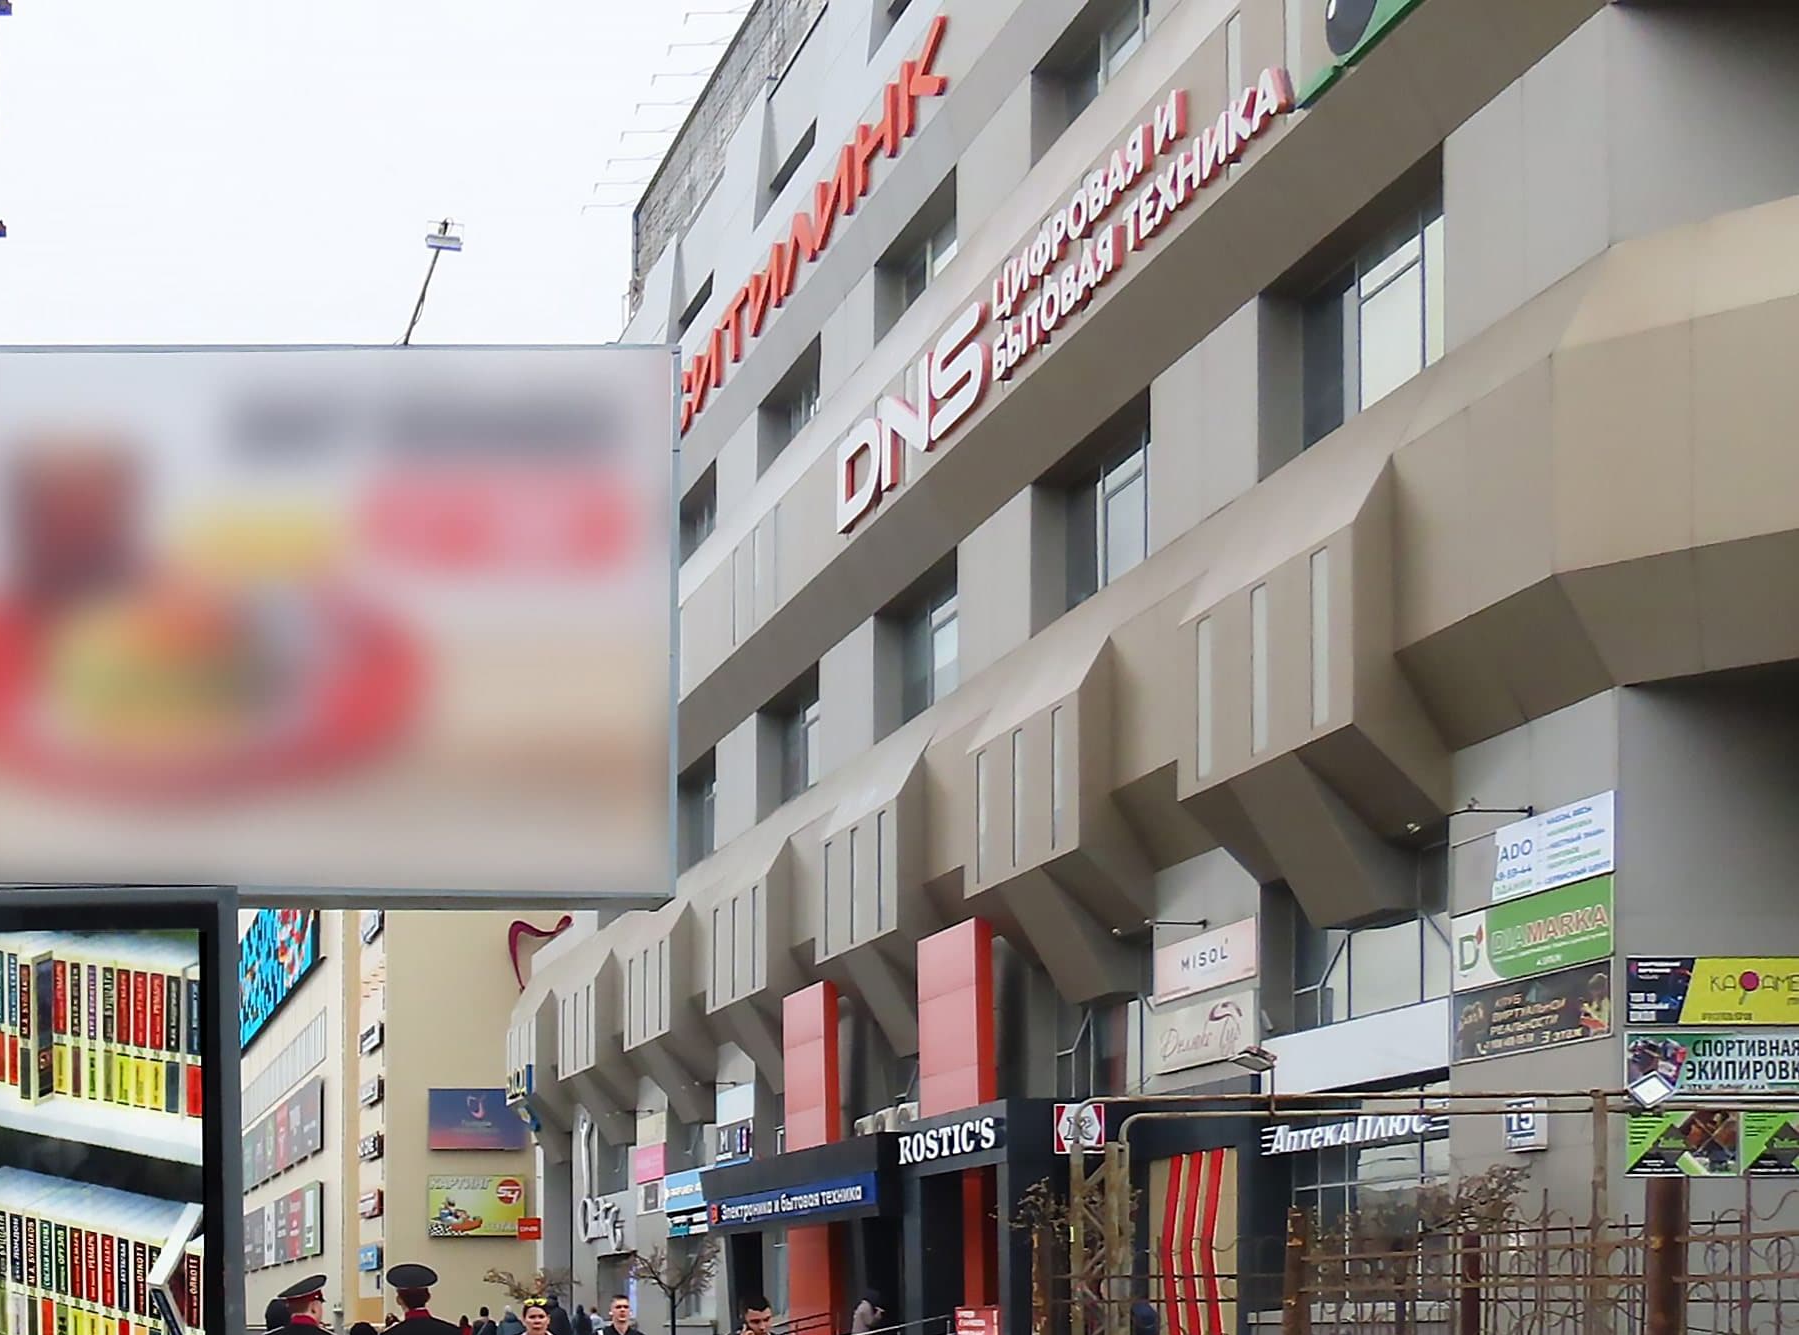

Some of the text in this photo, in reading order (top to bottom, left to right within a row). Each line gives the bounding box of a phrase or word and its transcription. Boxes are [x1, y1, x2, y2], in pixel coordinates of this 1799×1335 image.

[992, 88, 1187, 322] ЦИФРОВАЯ И
[992, 67, 1295, 382] БЫТОВАЯ ТЕХНИКА
[836, 301, 990, 534] DNS
[1491, 904, 1608, 951] DIAMARKA
[1489, 1013, 1560, 1036] РЕАЛЬНОСТИ
[898, 1117, 996, 1165] ROSTIC'S
[720, 1200, 773, 1223] Электроника
[780, 1192, 820, 1213] бытовая
[820, 1185, 862, 1203] техника
[87, 1235, 95, 1269] РЕМАРК
[136, 1246, 144, 1282] ОЛКОТТ
[189, 1258, 197, 1294] ОЛКОТТ
